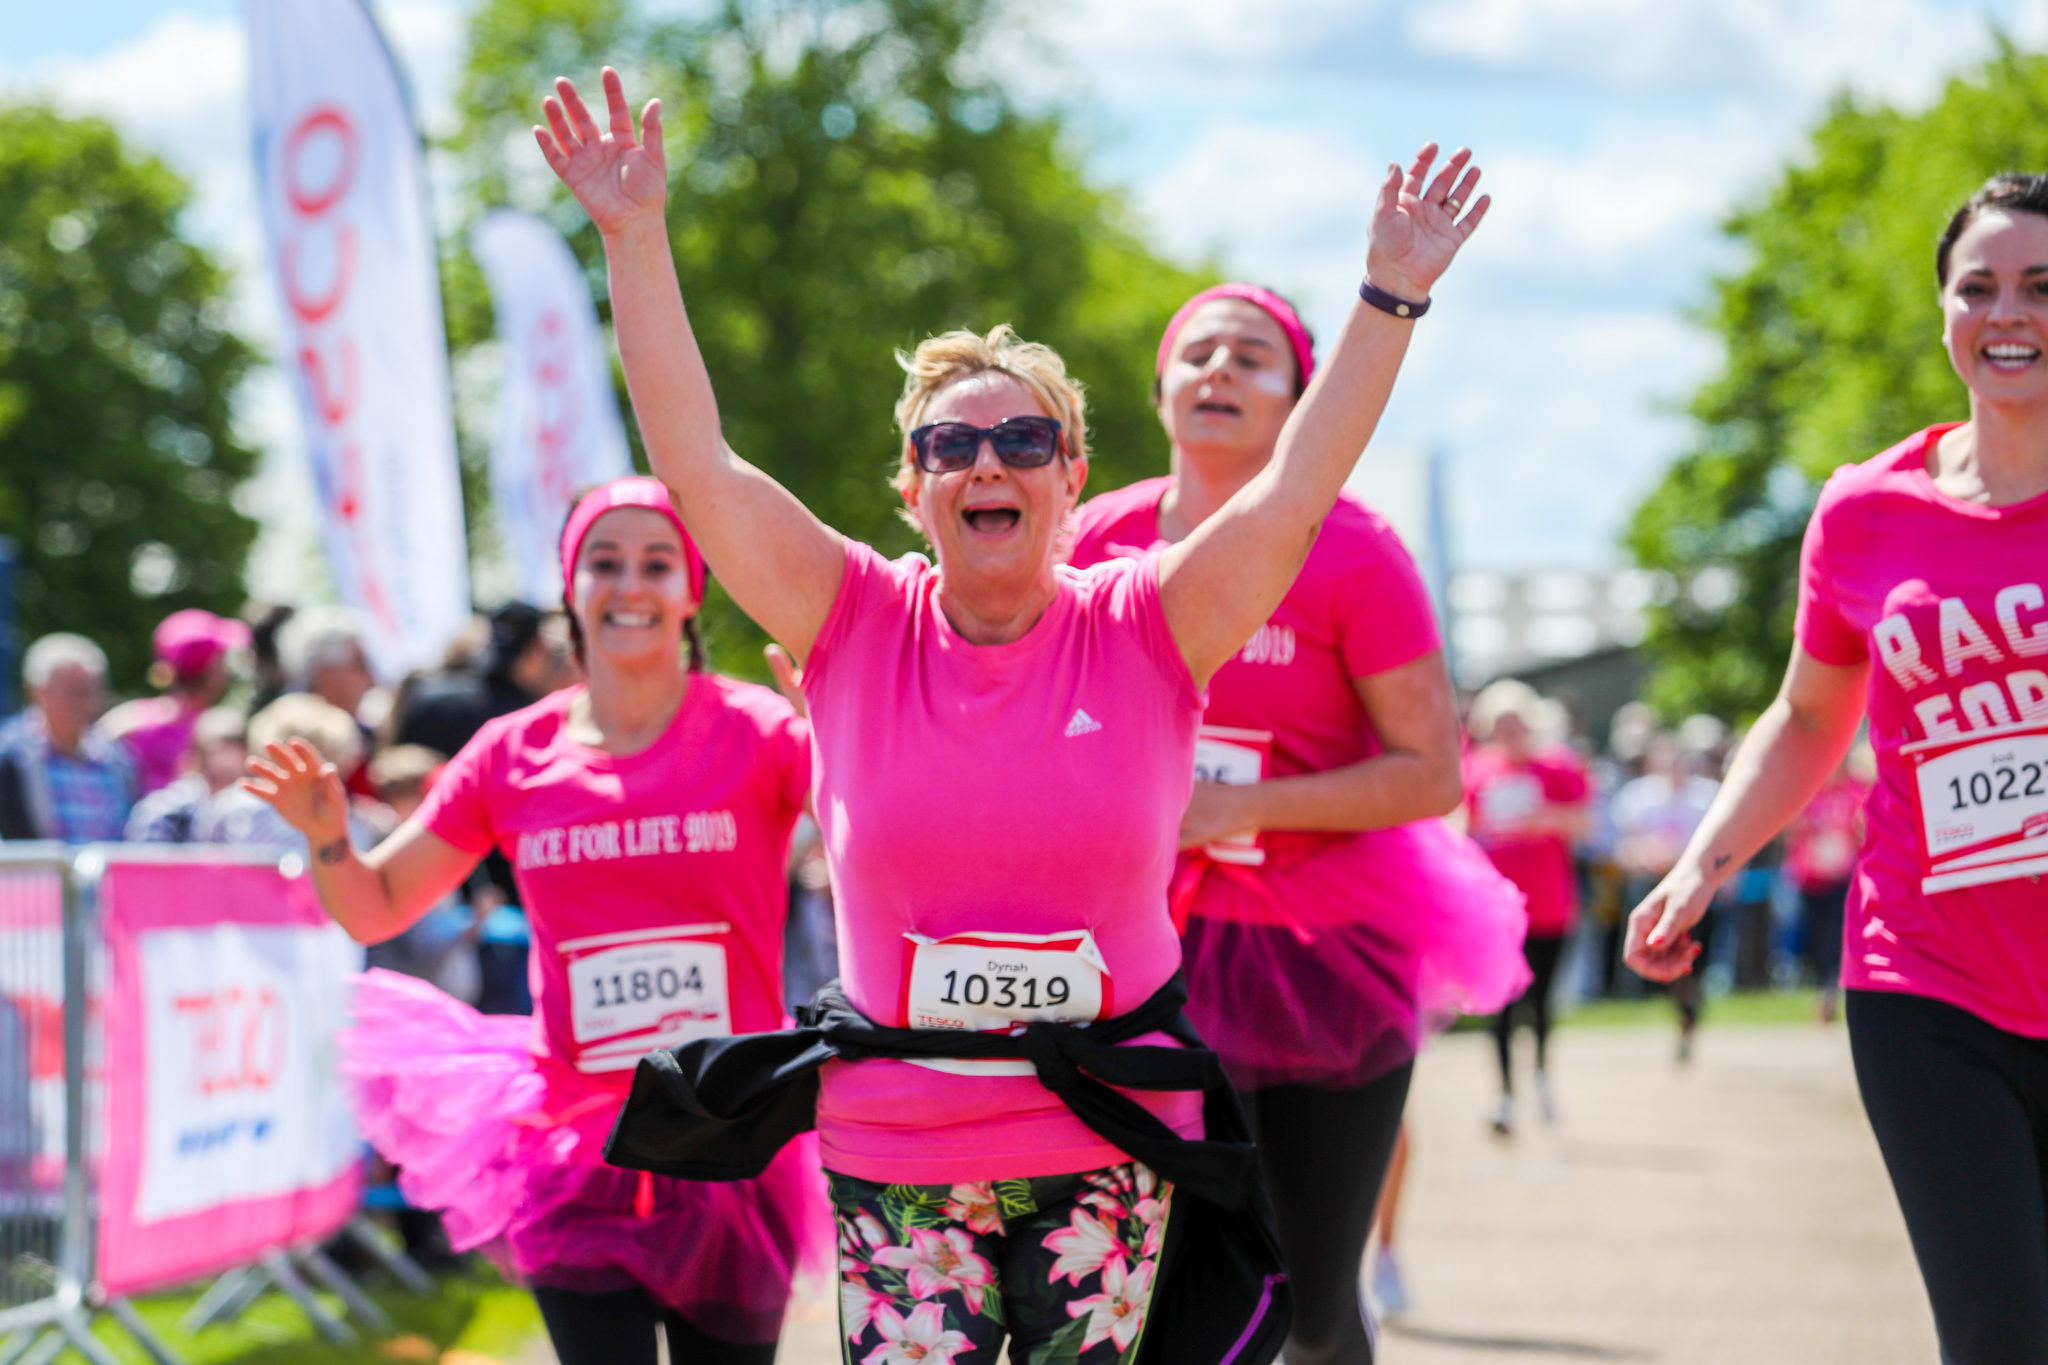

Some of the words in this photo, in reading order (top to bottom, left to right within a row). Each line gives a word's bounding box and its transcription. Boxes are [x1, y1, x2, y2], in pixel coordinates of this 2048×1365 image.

[1949, 759, 2048, 811] 1022
[568, 820, 622, 863] FOR
[623, 814, 682, 857] LIFE
[593, 965, 704, 1008] 11804
[987, 960, 1028, 974] Dynah
[940, 969, 1070, 1009] 10319
